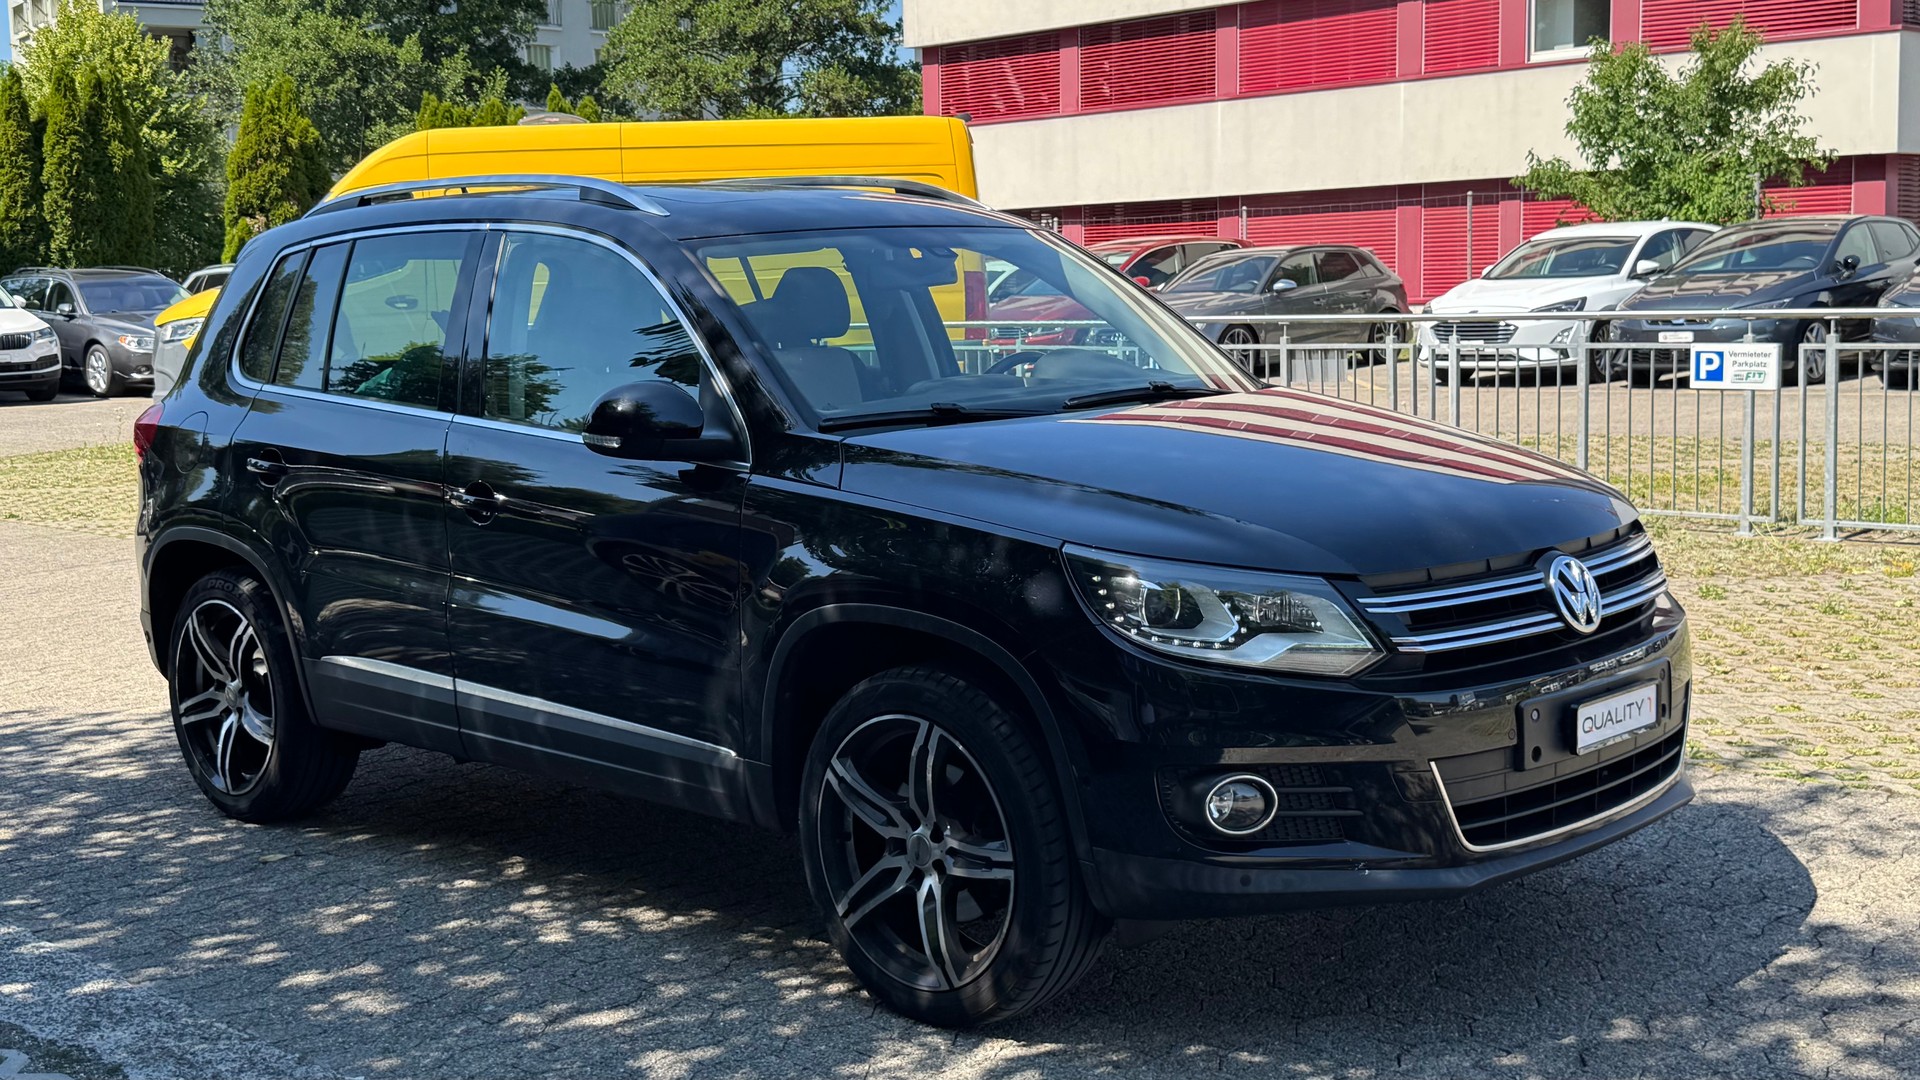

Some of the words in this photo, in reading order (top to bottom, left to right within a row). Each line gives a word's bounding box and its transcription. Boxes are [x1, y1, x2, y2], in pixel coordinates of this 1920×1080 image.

[1700, 352, 1720, 380] P
[1732, 360, 1767, 368] Parkplatz
[1745, 372, 1764, 381] FIT
[1582, 698, 1645, 734] QUALITY
[1647, 696, 1652, 713] 1
